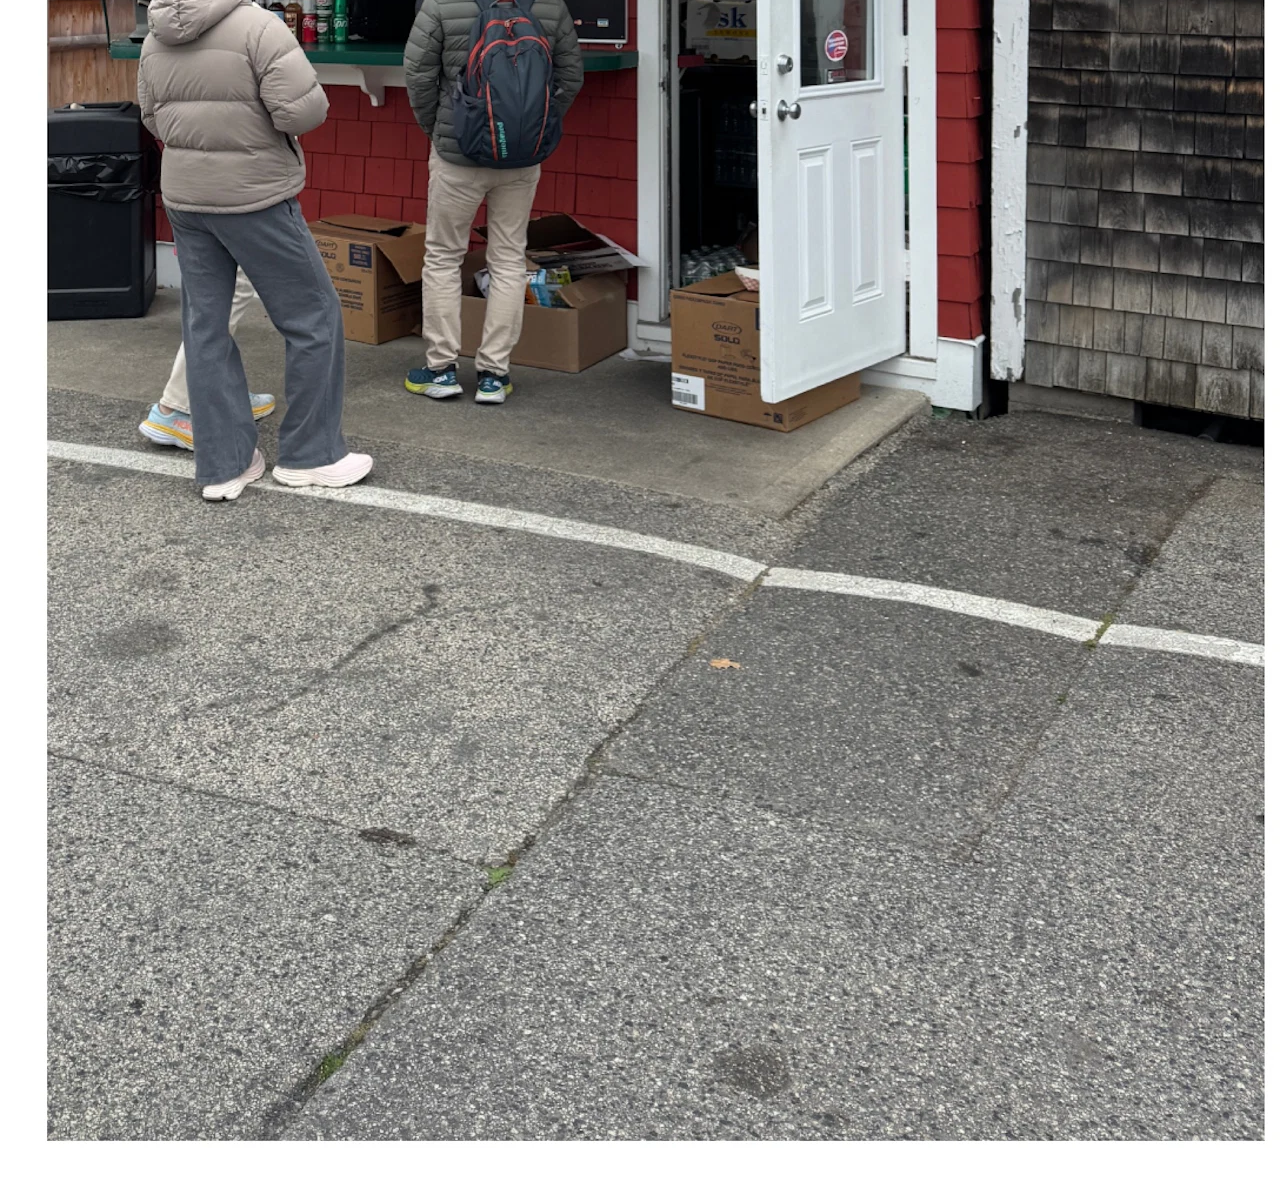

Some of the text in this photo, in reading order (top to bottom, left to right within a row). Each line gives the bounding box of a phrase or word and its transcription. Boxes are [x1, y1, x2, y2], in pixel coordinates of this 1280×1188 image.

[320, 251, 336, 259] OLO
[715, 324, 738, 332] DART
[714, 334, 740, 345] SOLO
